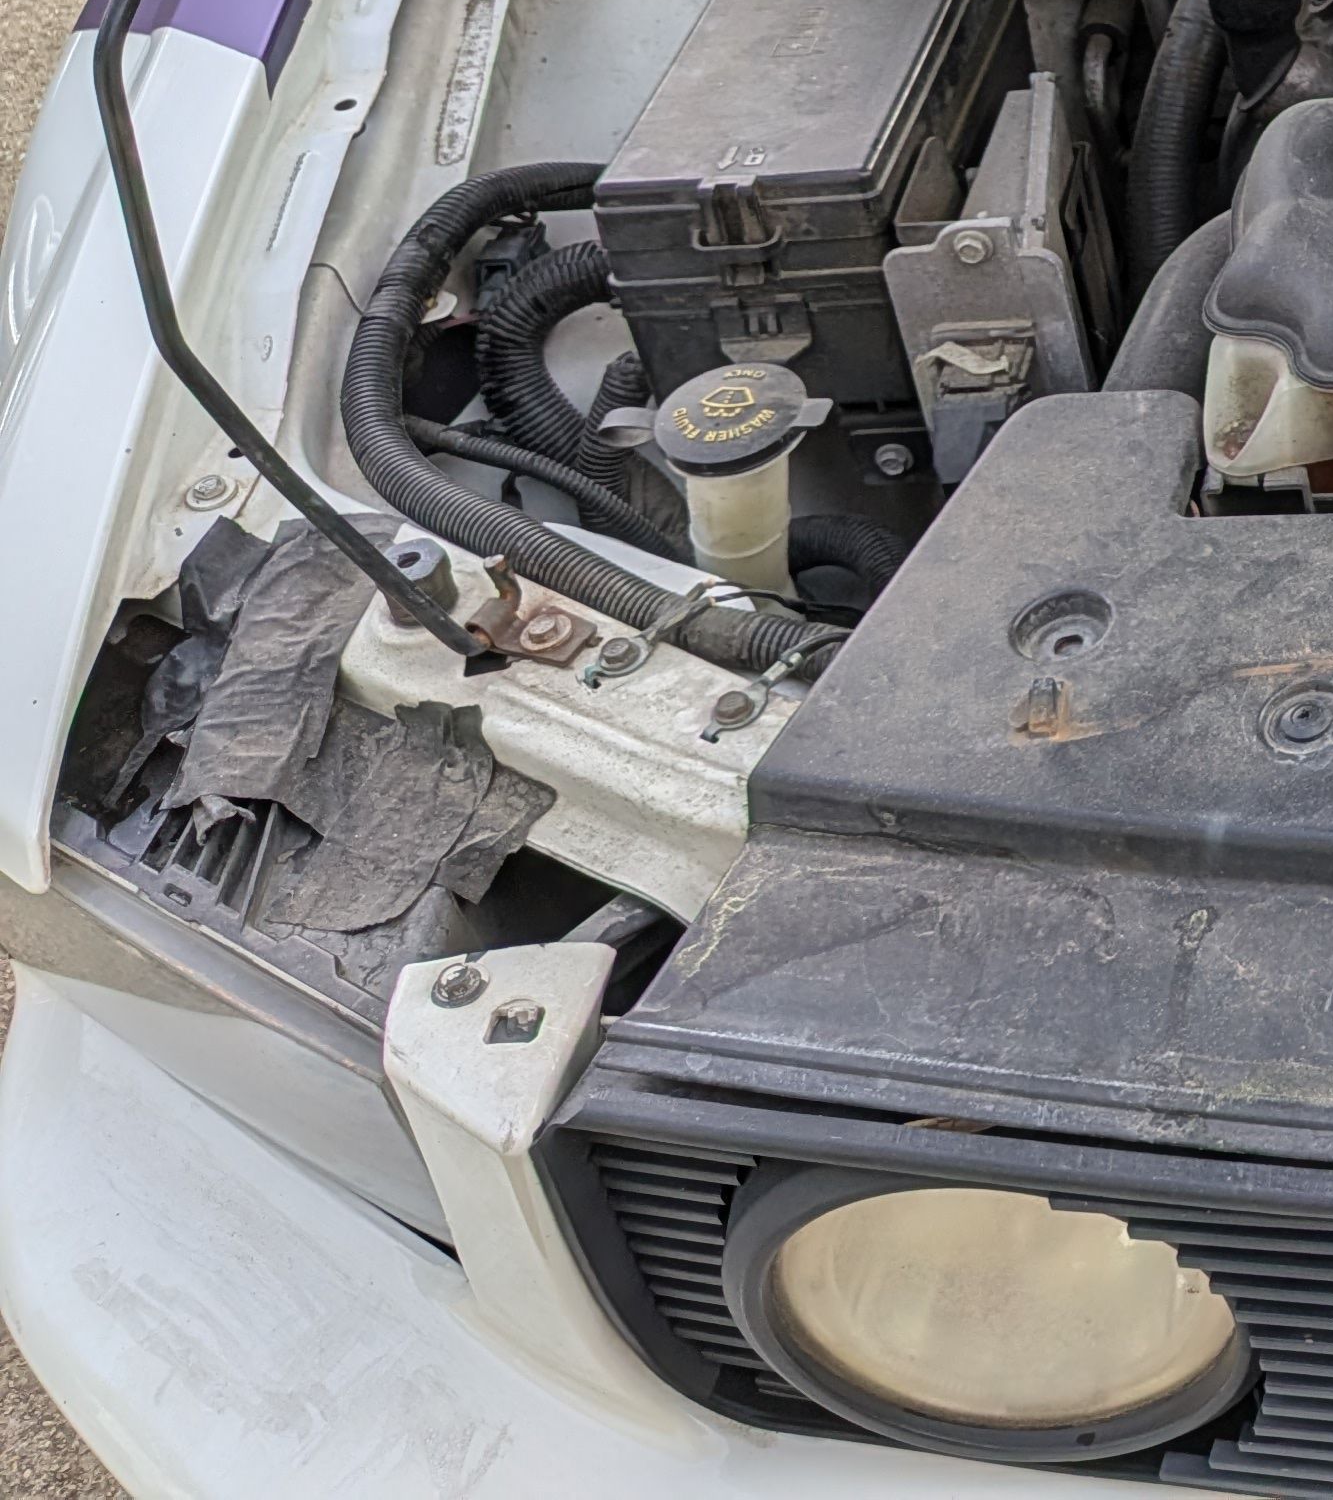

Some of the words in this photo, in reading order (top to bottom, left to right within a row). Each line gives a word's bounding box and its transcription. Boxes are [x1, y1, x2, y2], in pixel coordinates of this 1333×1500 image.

[723, 369, 767, 380] ONLY
[672, 407, 701, 440] FLUID
[704, 409, 776, 442] WASHER
